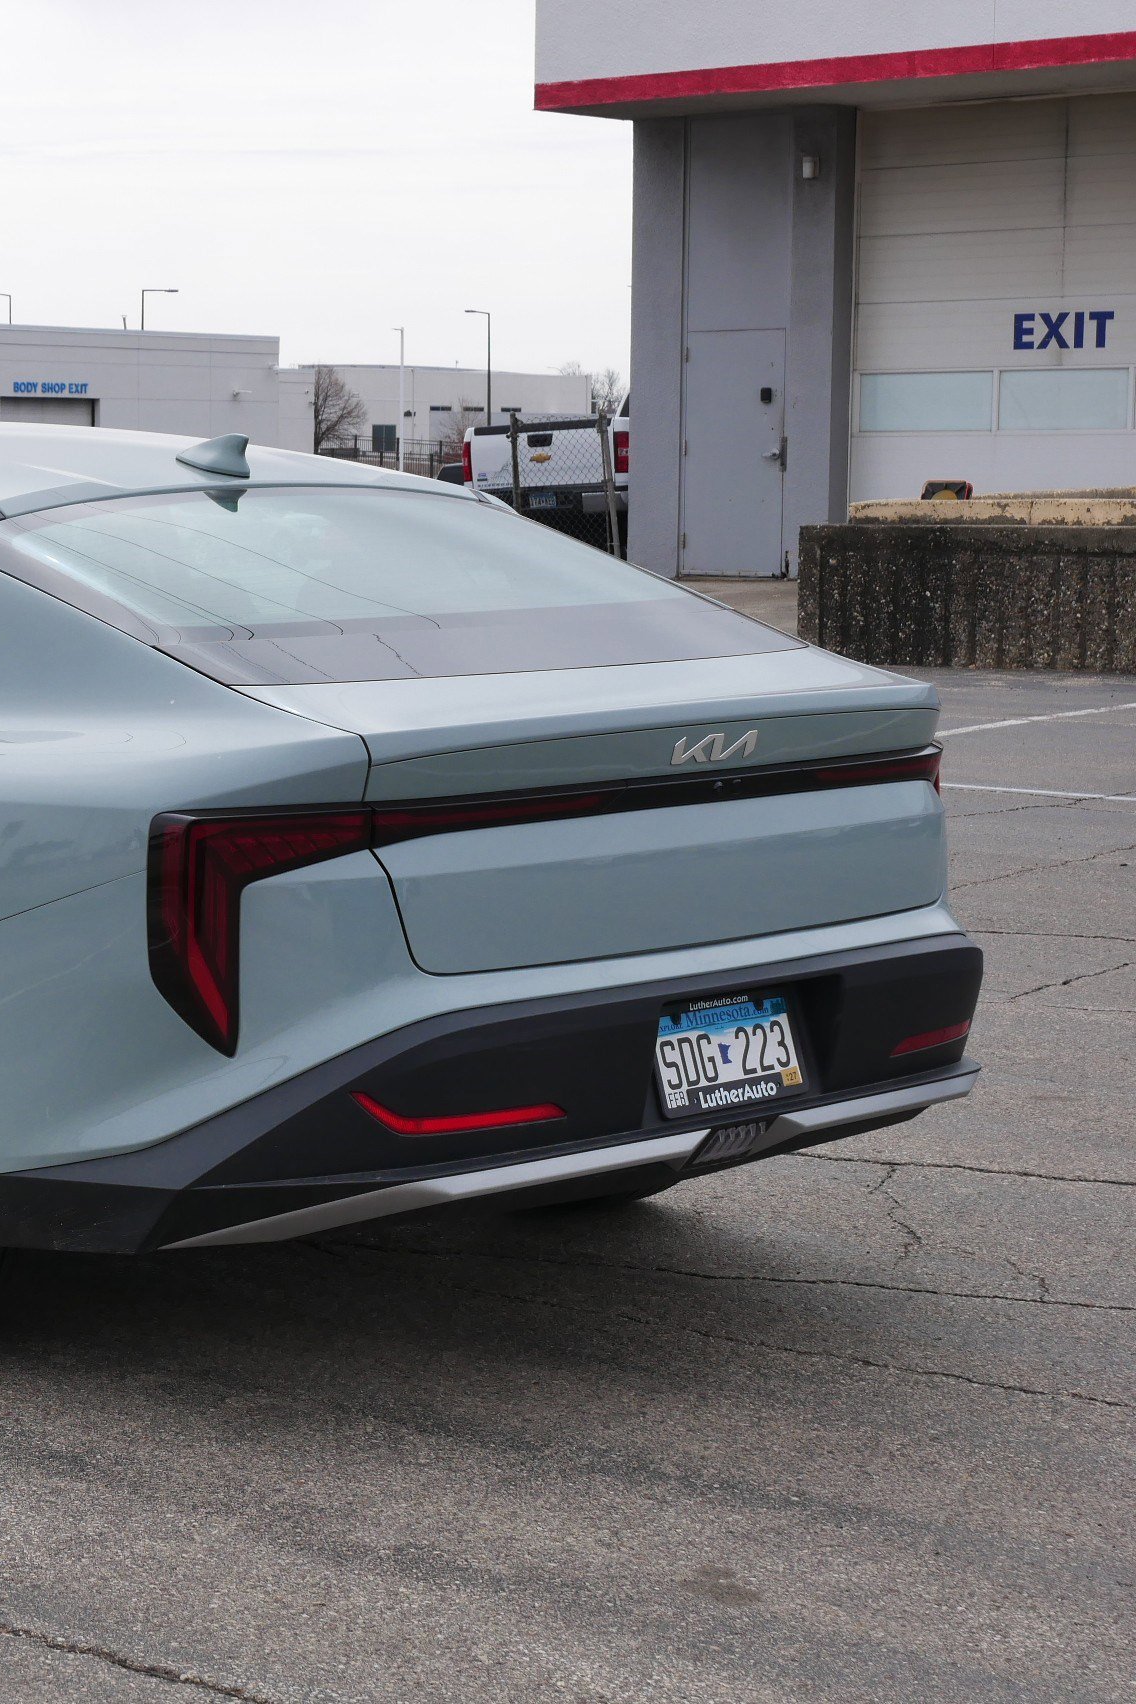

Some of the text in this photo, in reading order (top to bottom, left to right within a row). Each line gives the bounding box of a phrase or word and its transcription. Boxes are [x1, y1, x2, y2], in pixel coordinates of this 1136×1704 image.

[1013, 310, 1115, 350] EXIT
[13, 381, 89, 394] BODY SHOP EXIT
[670, 730, 758, 765] KIA
[689, 994, 749, 1011] LutherAuto.com
[659, 1020, 791, 1091] SDG 223
[698, 1080, 778, 1109] LutherAuto
